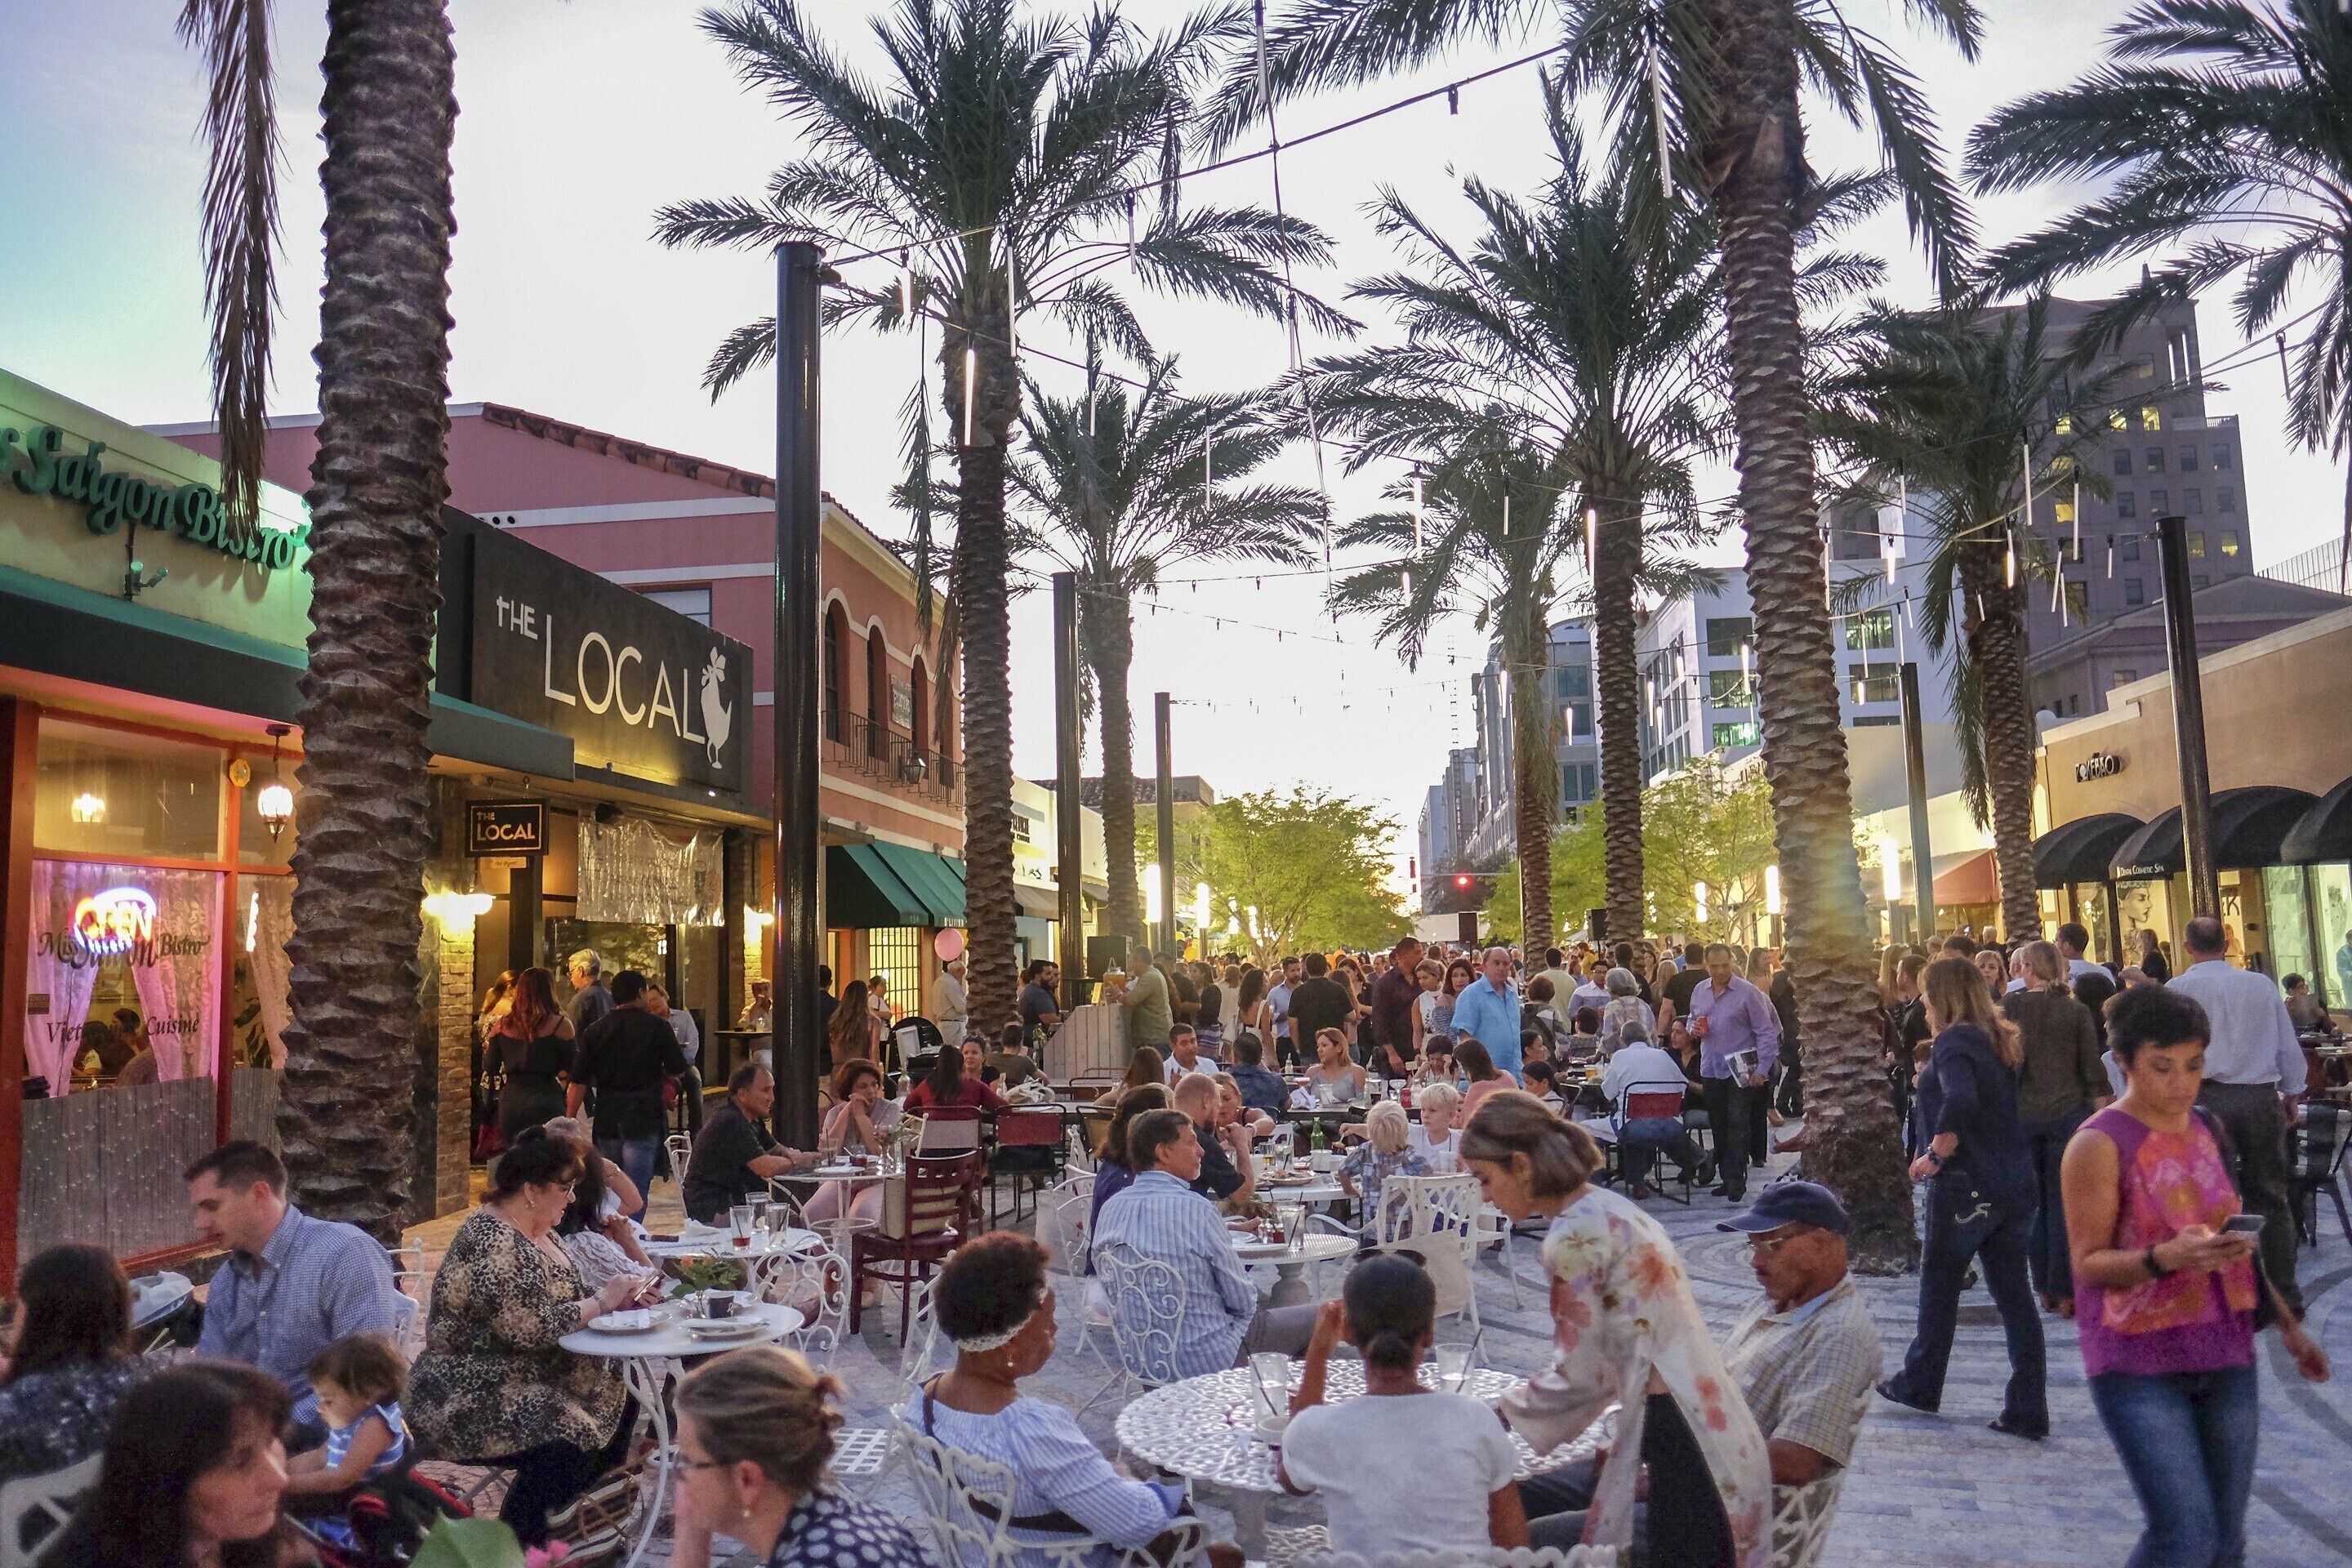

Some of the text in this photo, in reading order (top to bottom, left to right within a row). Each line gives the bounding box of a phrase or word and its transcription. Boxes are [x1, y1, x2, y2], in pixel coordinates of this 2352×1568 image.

[12, 425, 177, 535] Saigon
[545, 613, 706, 745] LOCAL
[477, 822, 536, 842] LOCAL
[75, 898, 155, 941] OPEN
[160, 932, 211, 956] Bistro
[146, 1013, 200, 1036] Cuisine
